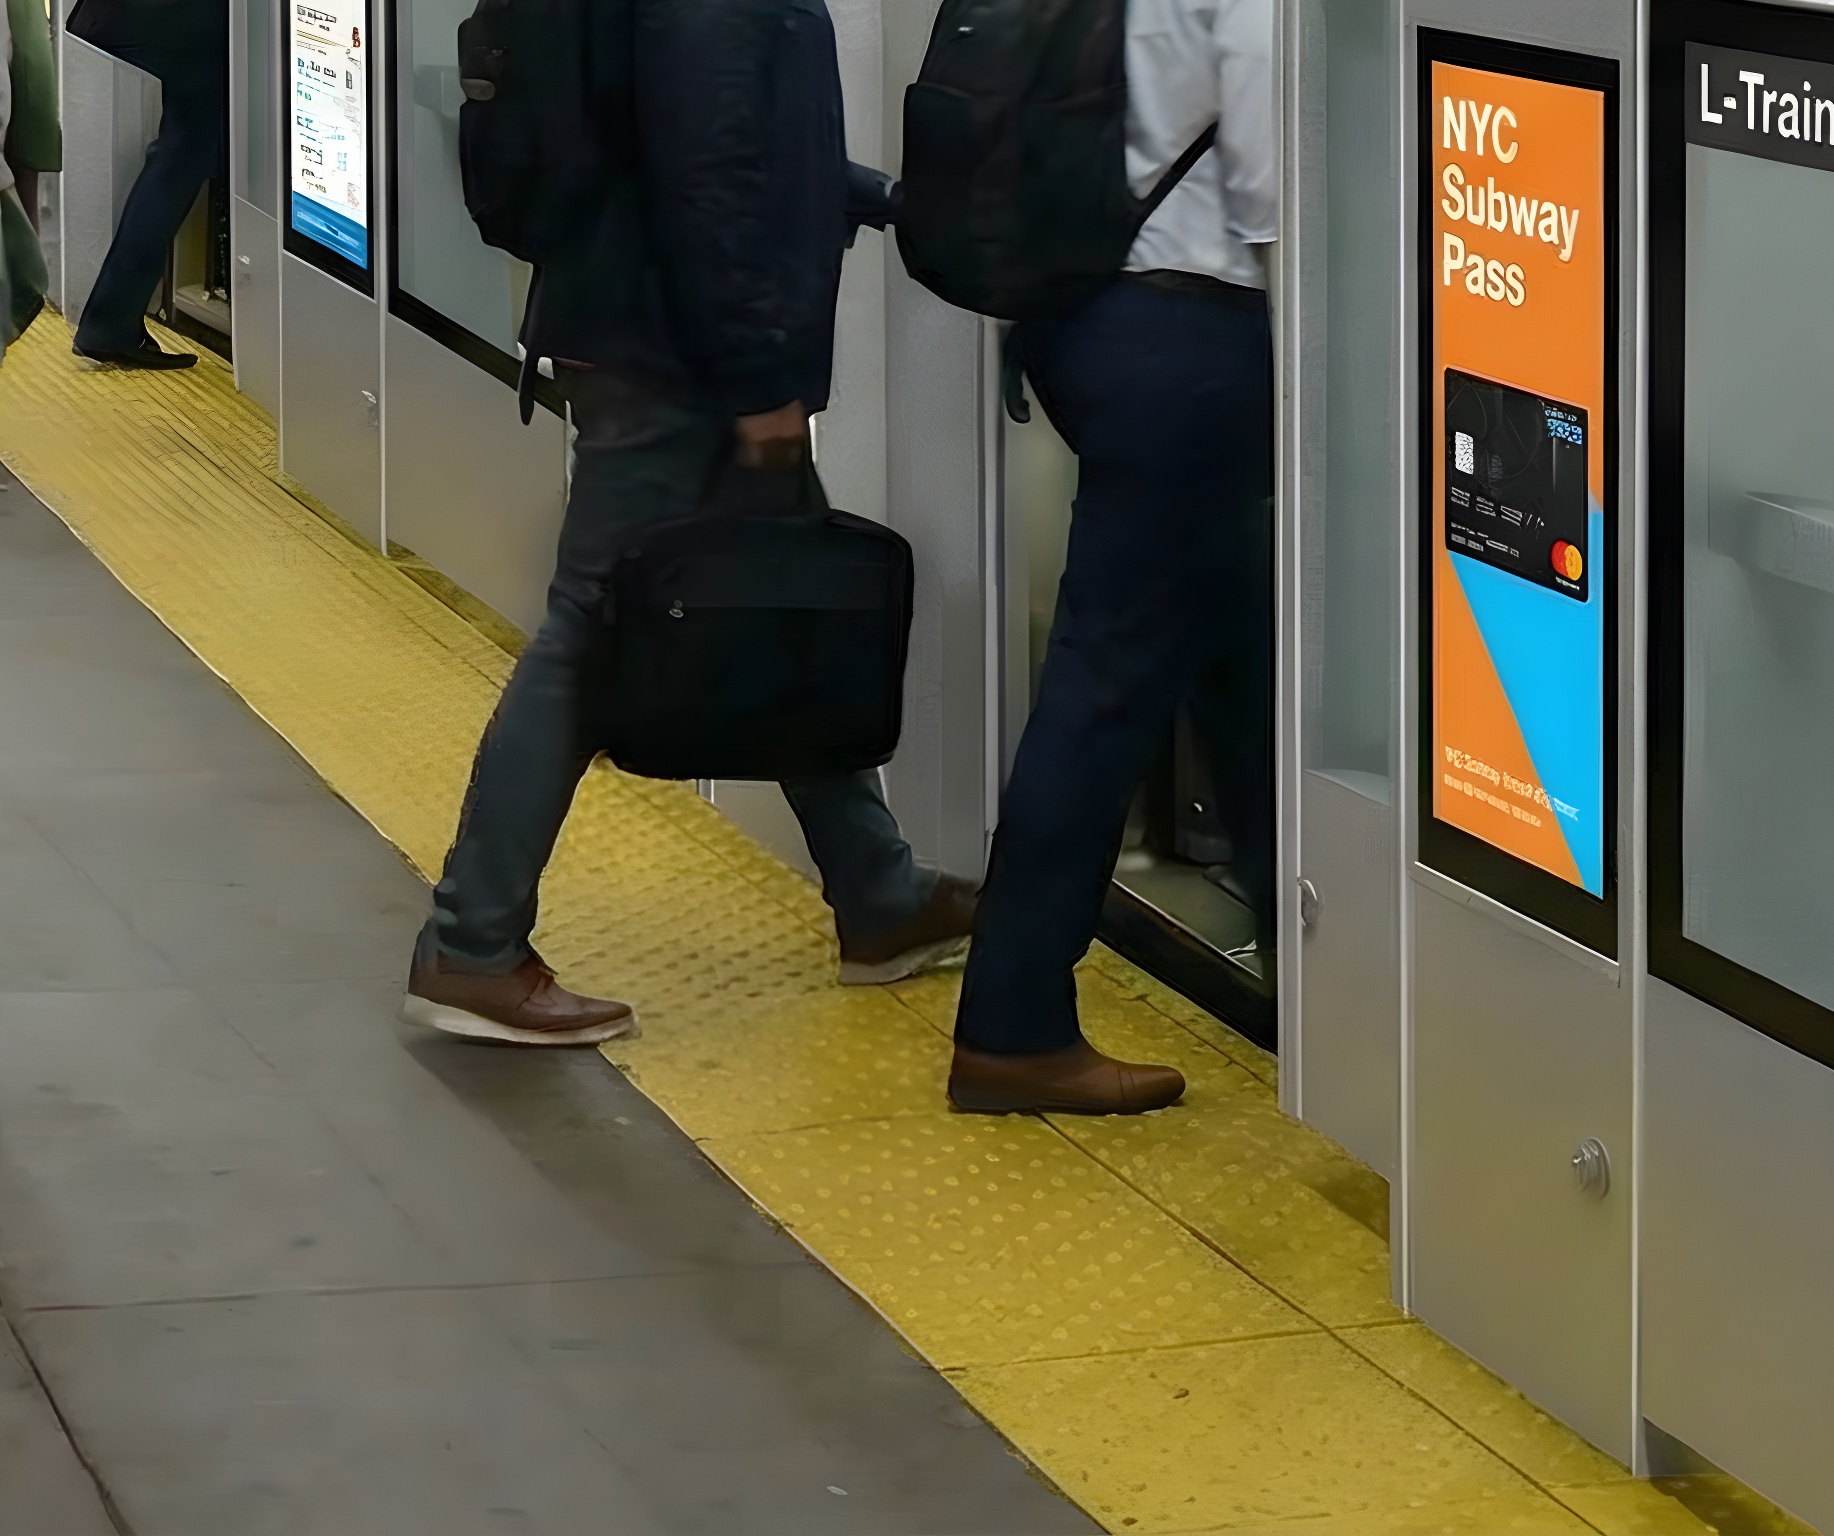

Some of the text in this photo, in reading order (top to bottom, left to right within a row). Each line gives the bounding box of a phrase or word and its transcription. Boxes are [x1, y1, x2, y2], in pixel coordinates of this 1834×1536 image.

[1443, 96, 1519, 164] NYC
[1442, 164, 1579, 262] Subway
[1443, 231, 1526, 307] Pass
